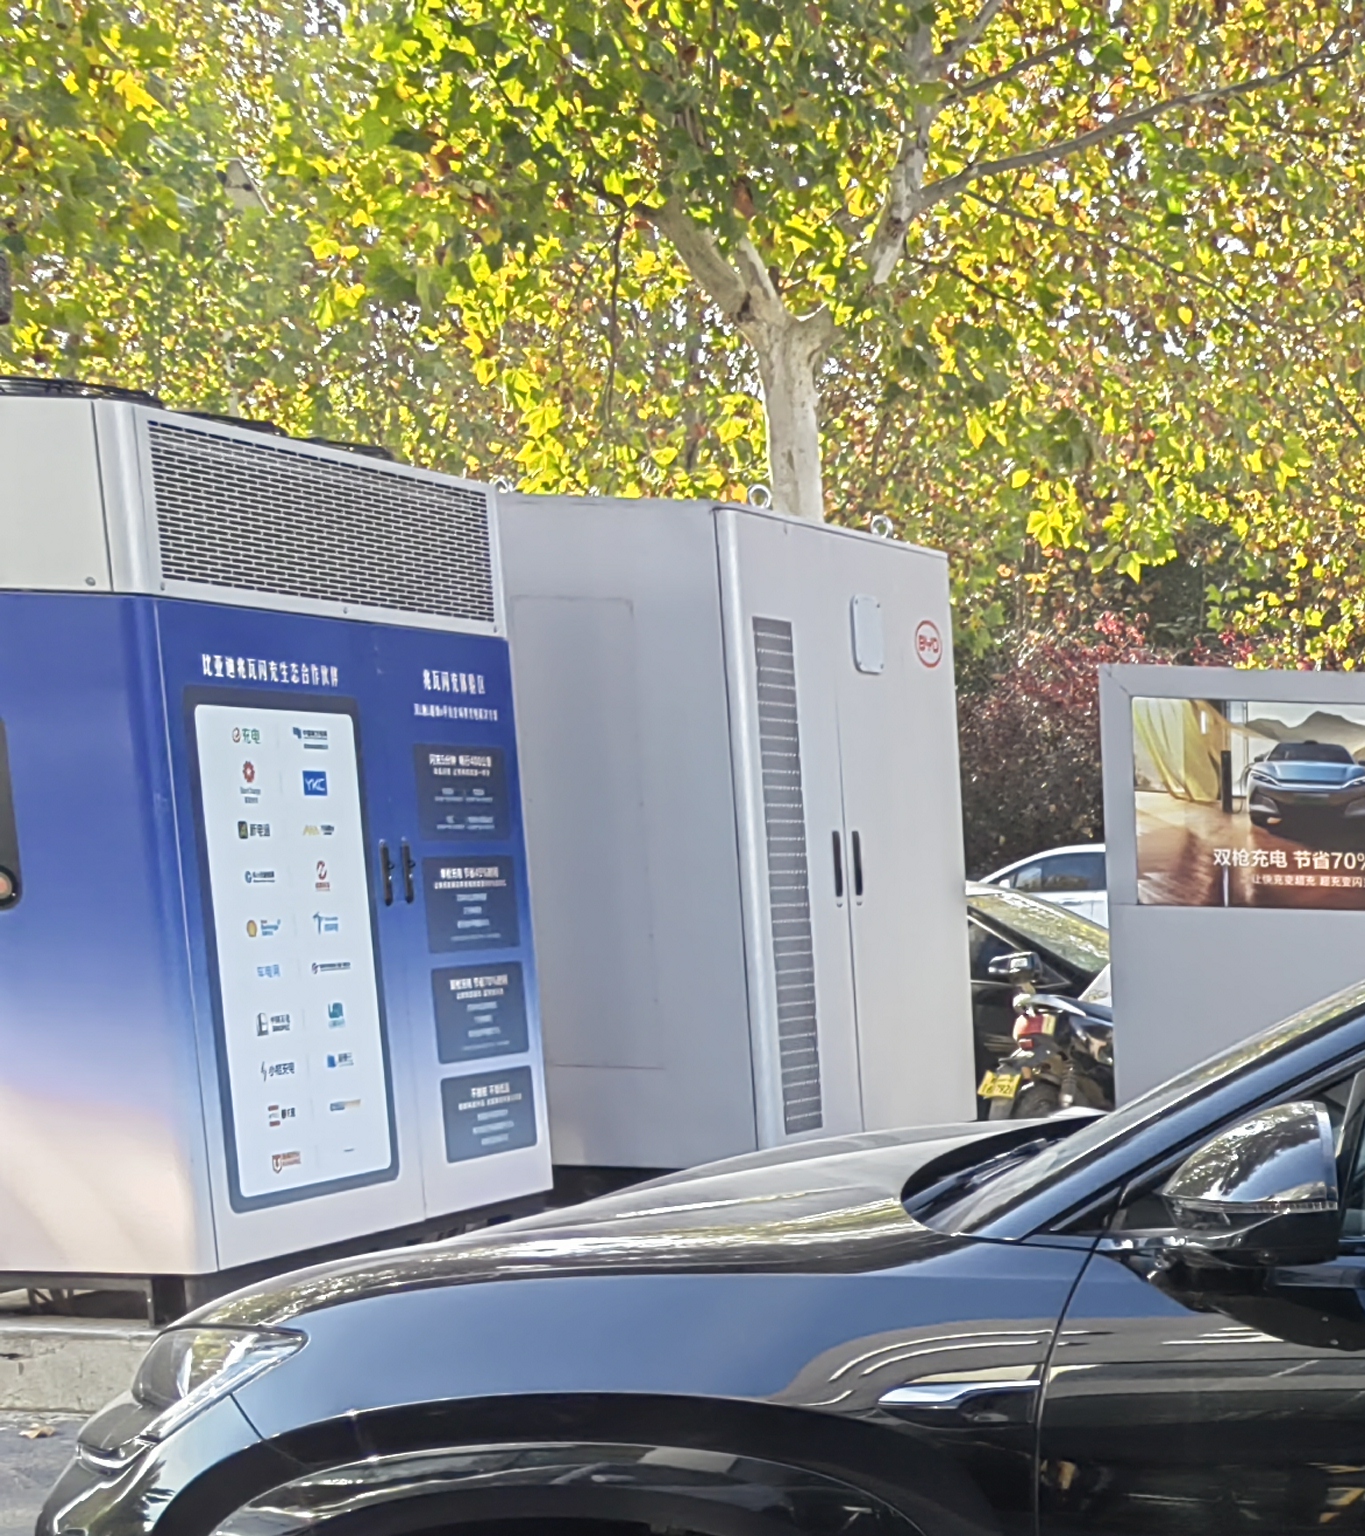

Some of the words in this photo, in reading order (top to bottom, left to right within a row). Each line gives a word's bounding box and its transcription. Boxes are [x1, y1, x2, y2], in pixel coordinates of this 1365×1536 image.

[1213, 848, 1288, 868] 双枪充电
[1252, 874, 1317, 887] 让快充变超充
